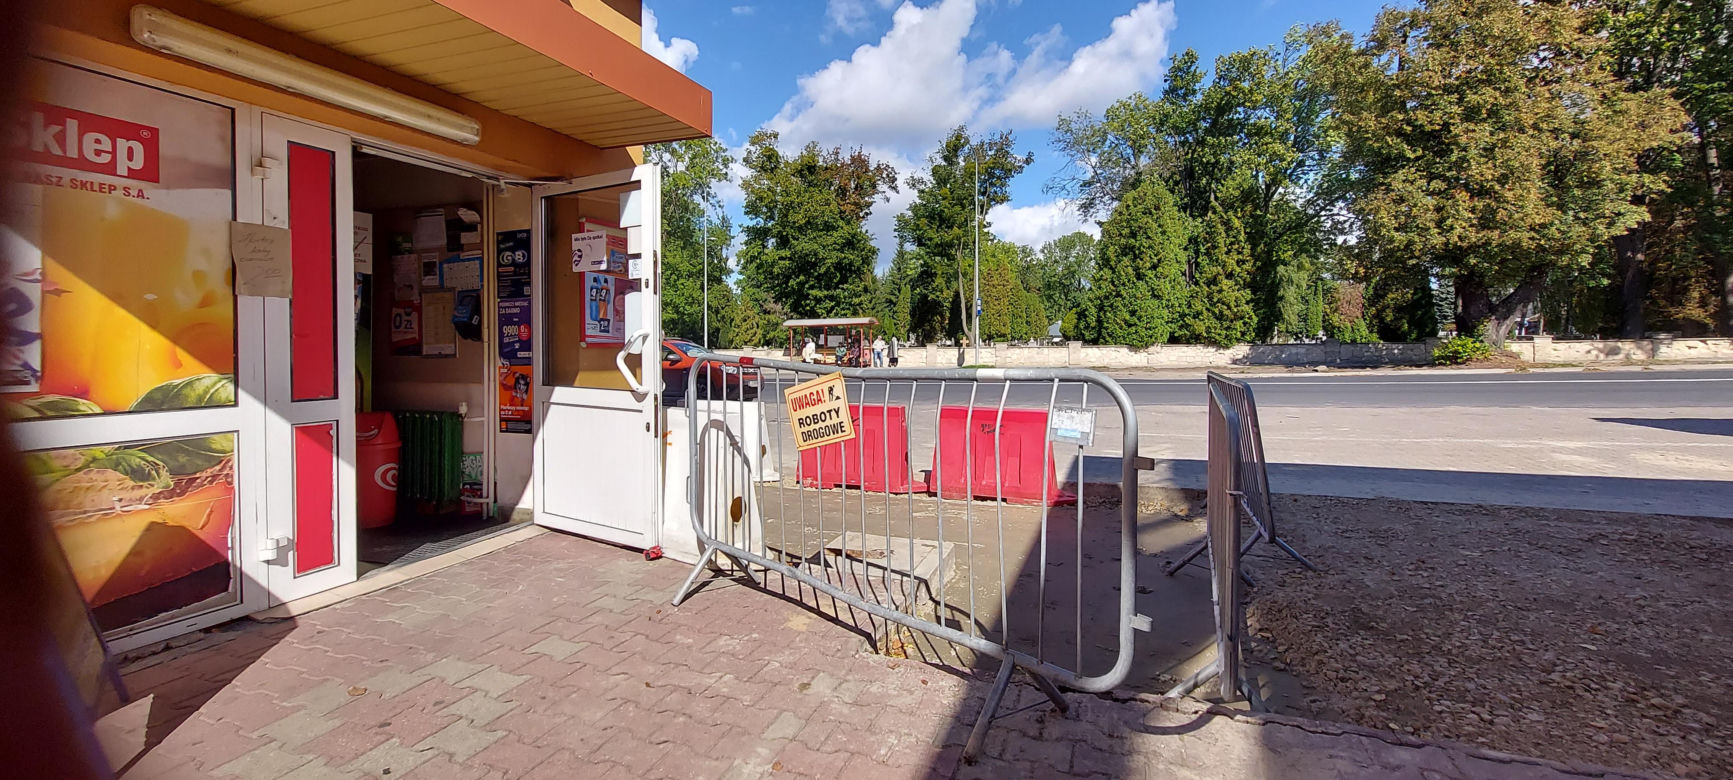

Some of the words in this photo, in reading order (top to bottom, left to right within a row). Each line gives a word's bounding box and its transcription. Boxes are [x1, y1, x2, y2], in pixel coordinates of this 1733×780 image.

[69, 178, 117, 194] SKLEP
[122, 187, 151, 200] S.A.
[790, 388, 826, 412] UWAGA!
[798, 407, 840, 428] ROBOTY
[801, 421, 846, 442] DROGOWE
